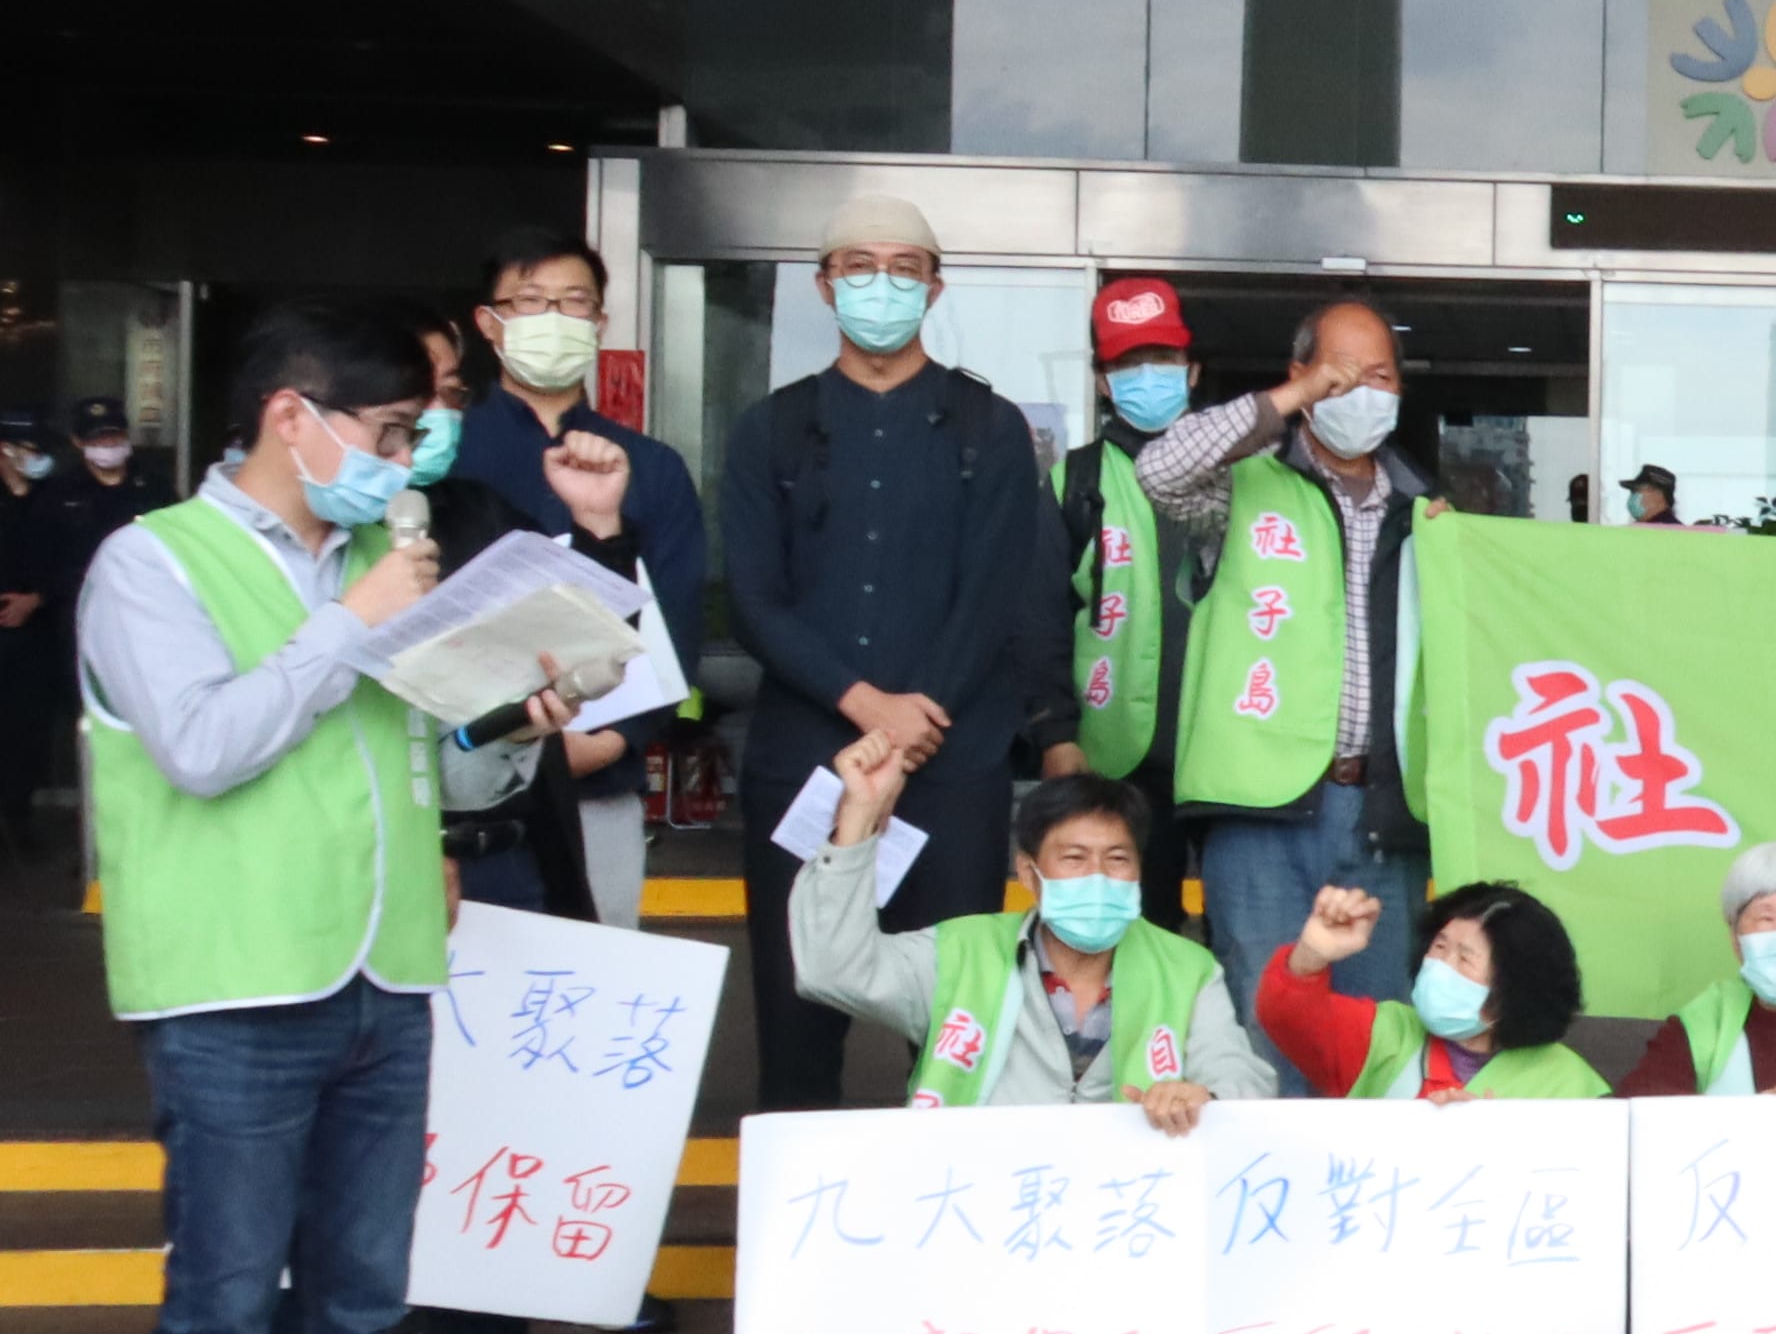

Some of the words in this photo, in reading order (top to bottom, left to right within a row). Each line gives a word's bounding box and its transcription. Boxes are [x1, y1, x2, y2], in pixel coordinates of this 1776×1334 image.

[1237, 515, 1304, 717] 社子島
[786, 1163, 1178, 1261] 九大聚落
[1216, 1151, 1583, 1266] 反對全區
